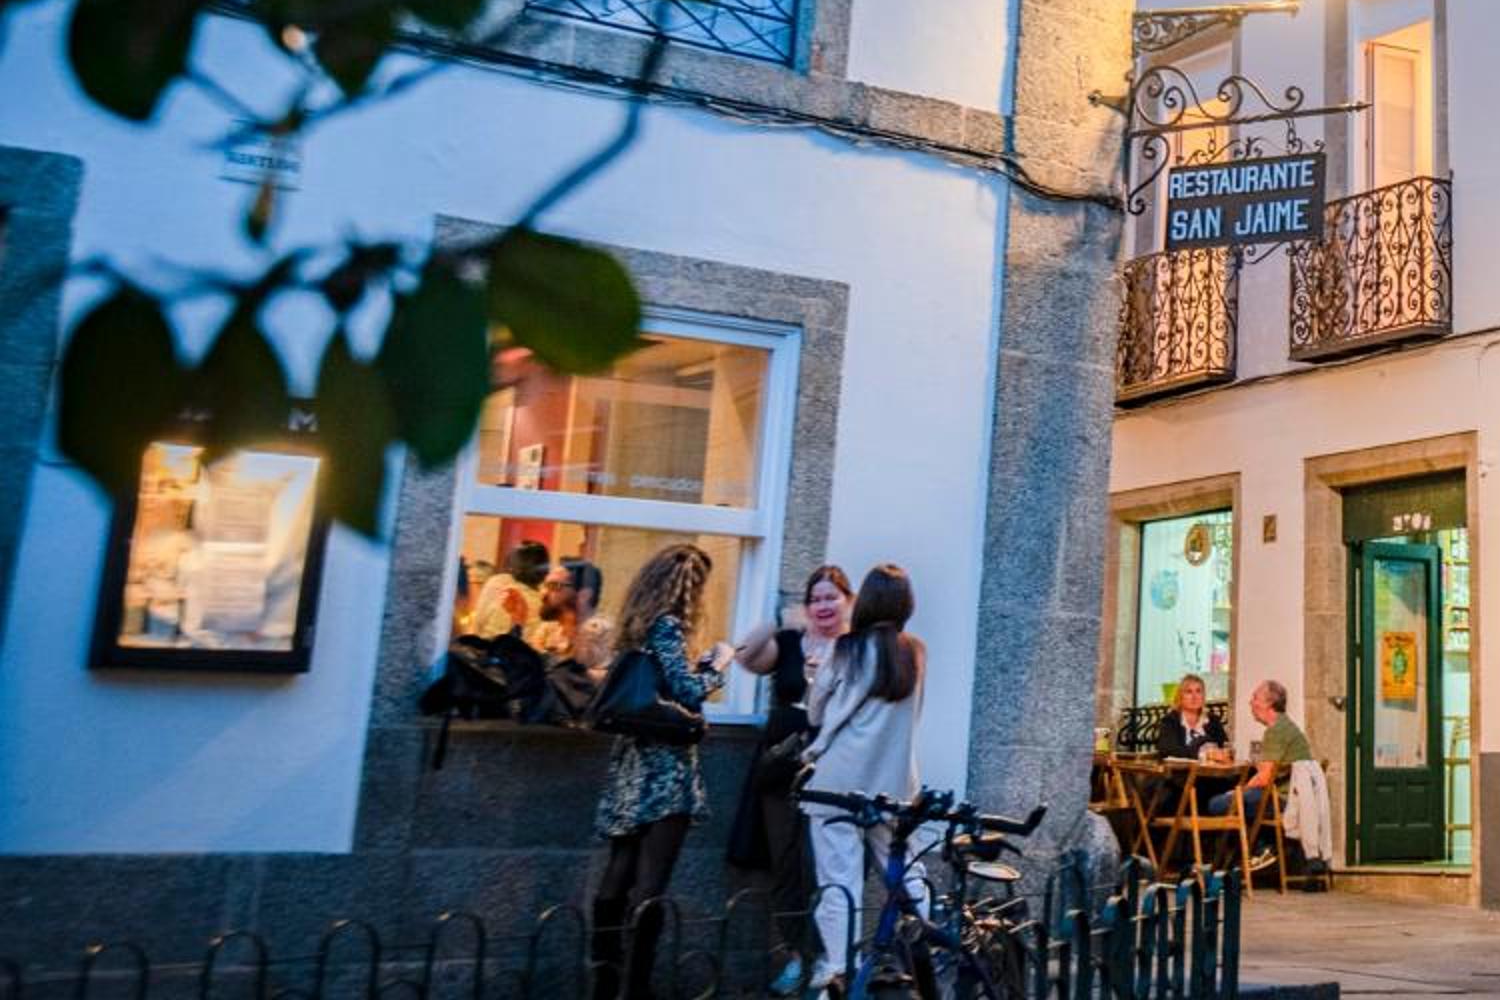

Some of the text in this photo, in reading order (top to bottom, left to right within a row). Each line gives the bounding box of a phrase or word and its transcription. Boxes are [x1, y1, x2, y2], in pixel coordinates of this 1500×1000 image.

[1169, 160, 1314, 198] RESTAURANTE
[1170, 200, 1308, 241] SAN JAIME
